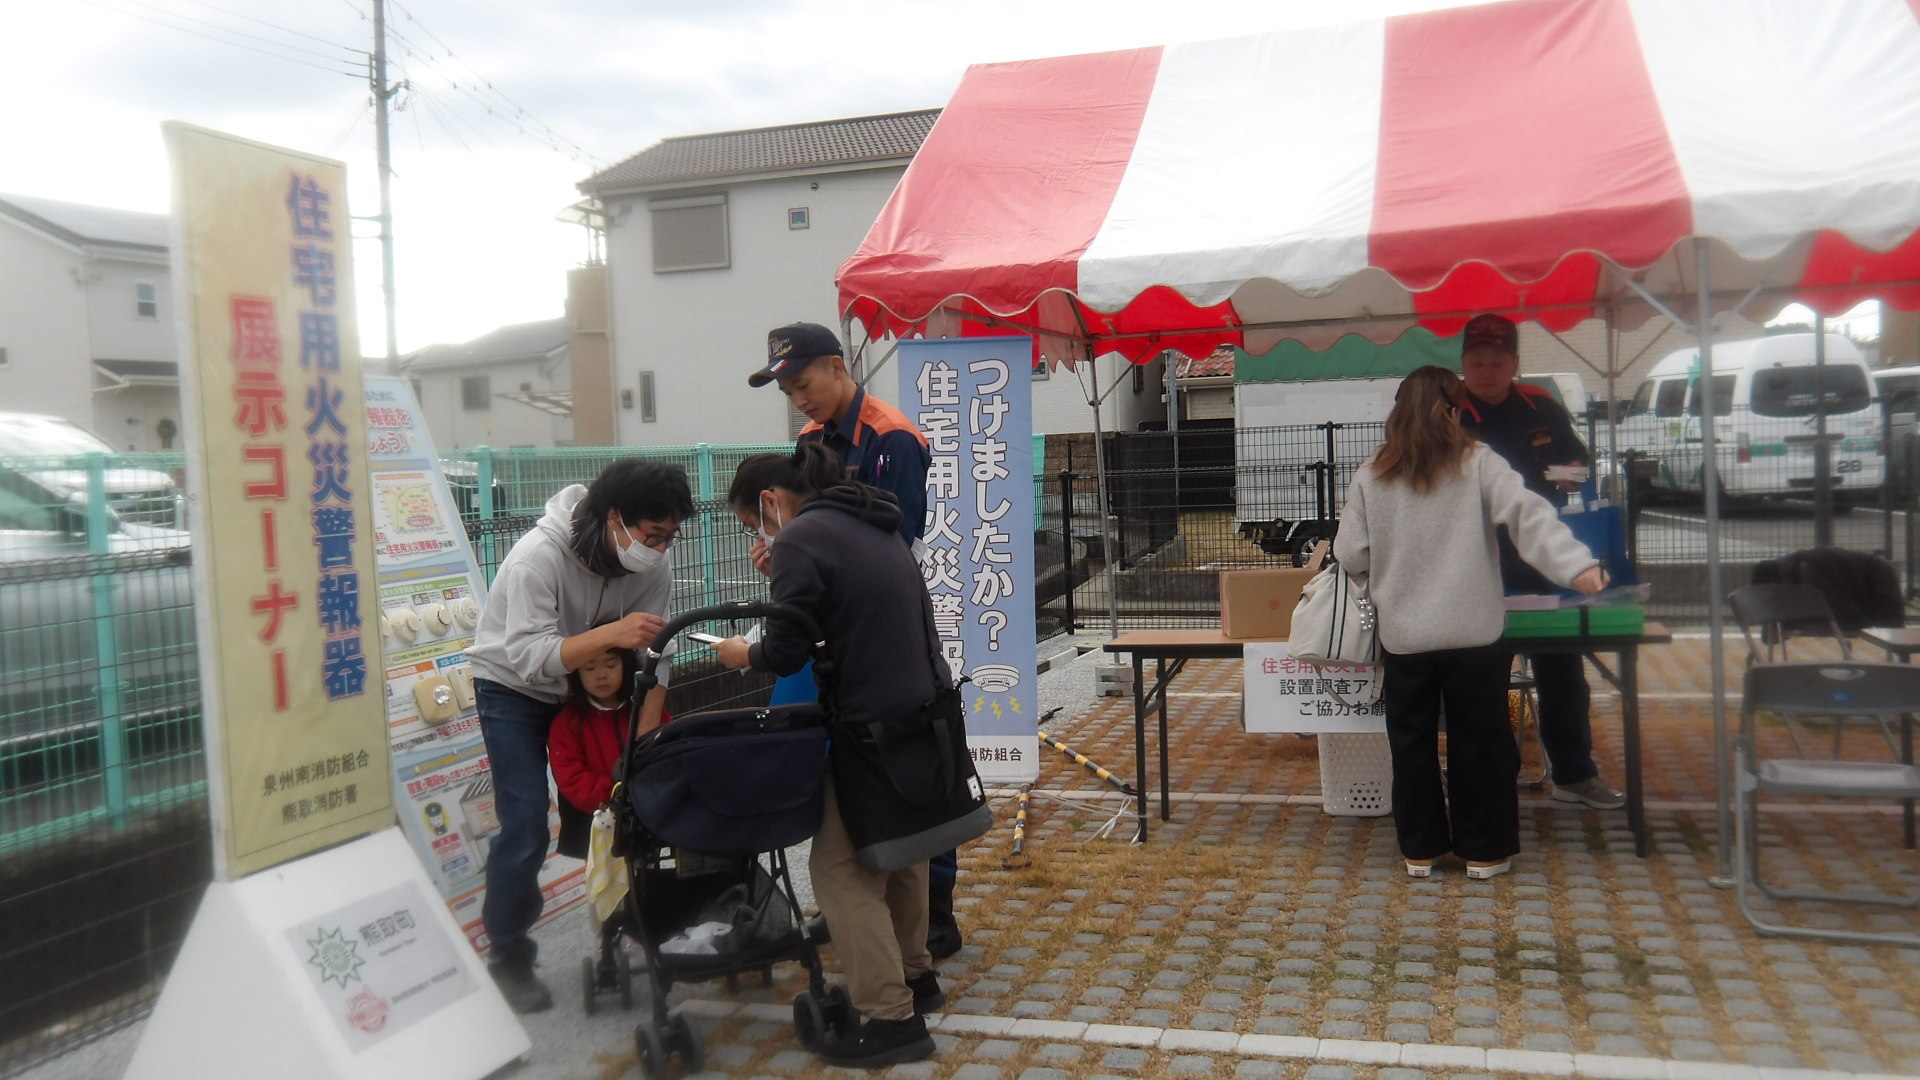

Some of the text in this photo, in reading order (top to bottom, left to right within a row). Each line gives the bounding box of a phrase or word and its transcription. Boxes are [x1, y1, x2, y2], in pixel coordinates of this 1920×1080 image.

[230, 294, 300, 711] 展示コーナー
[286, 173, 366, 701] 住宅用火災警報器
[969, 358, 1014, 653] つけましたか？
[263, 748, 370, 797] 泉州南消防組合
[281, 783, 358, 825] 熊取消防署
